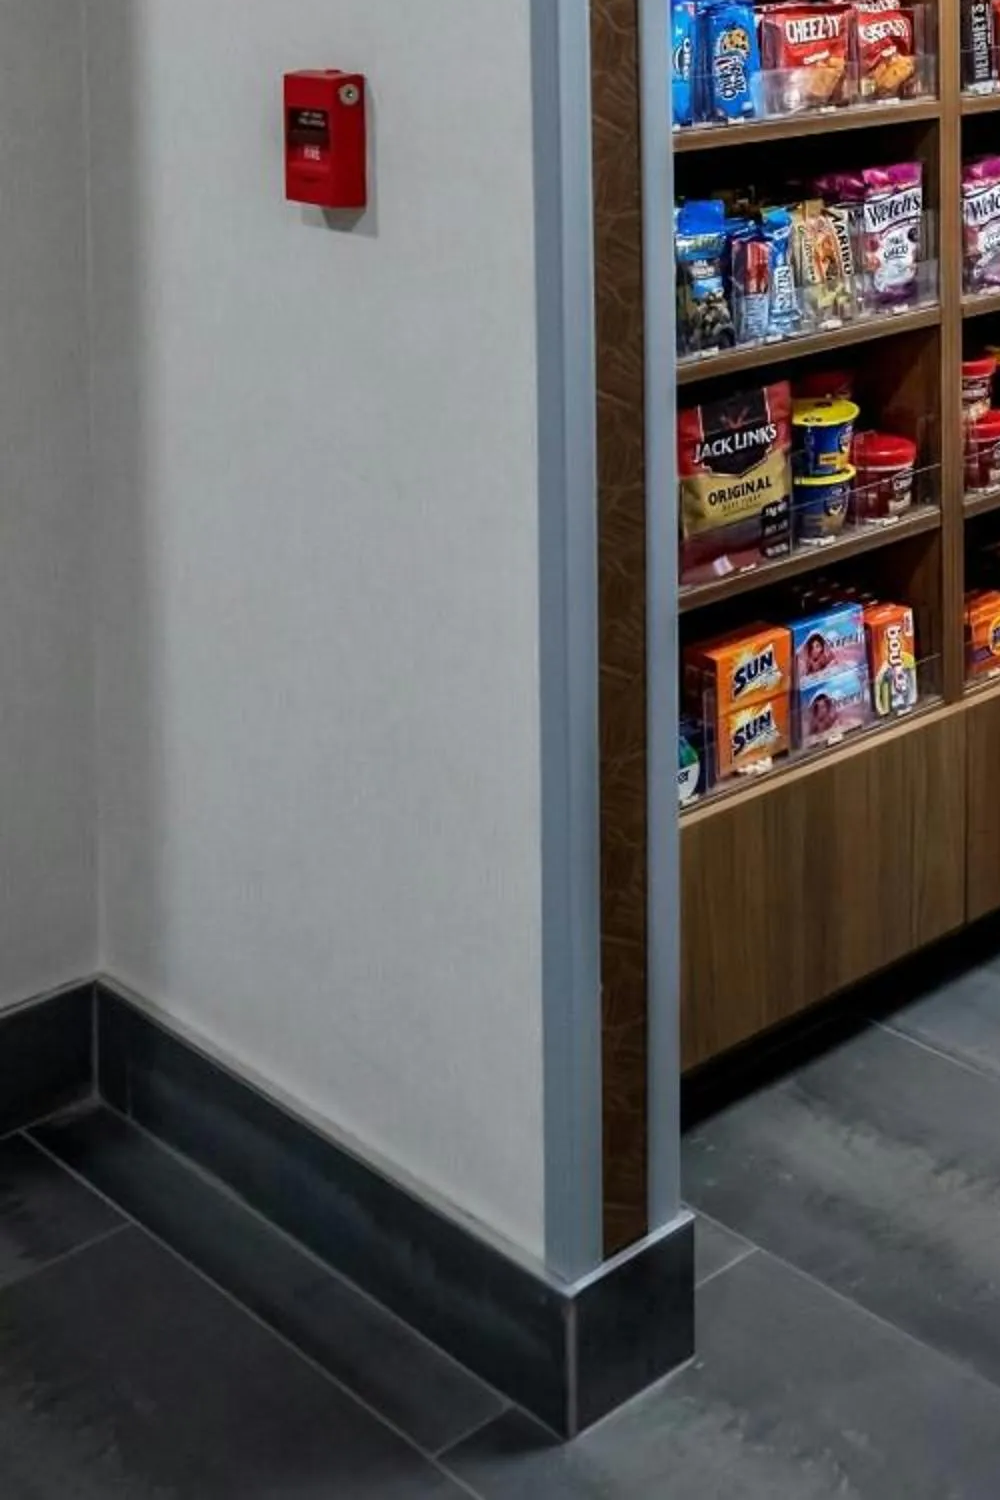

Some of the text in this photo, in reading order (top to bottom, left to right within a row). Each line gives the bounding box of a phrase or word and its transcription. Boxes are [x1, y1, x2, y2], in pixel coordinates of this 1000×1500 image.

[693, 422, 777, 463] JACK LINK'S
[707, 475, 773, 507] ORIGINAL
[733, 650, 774, 698] SUN
[731, 709, 772, 757] SUN
